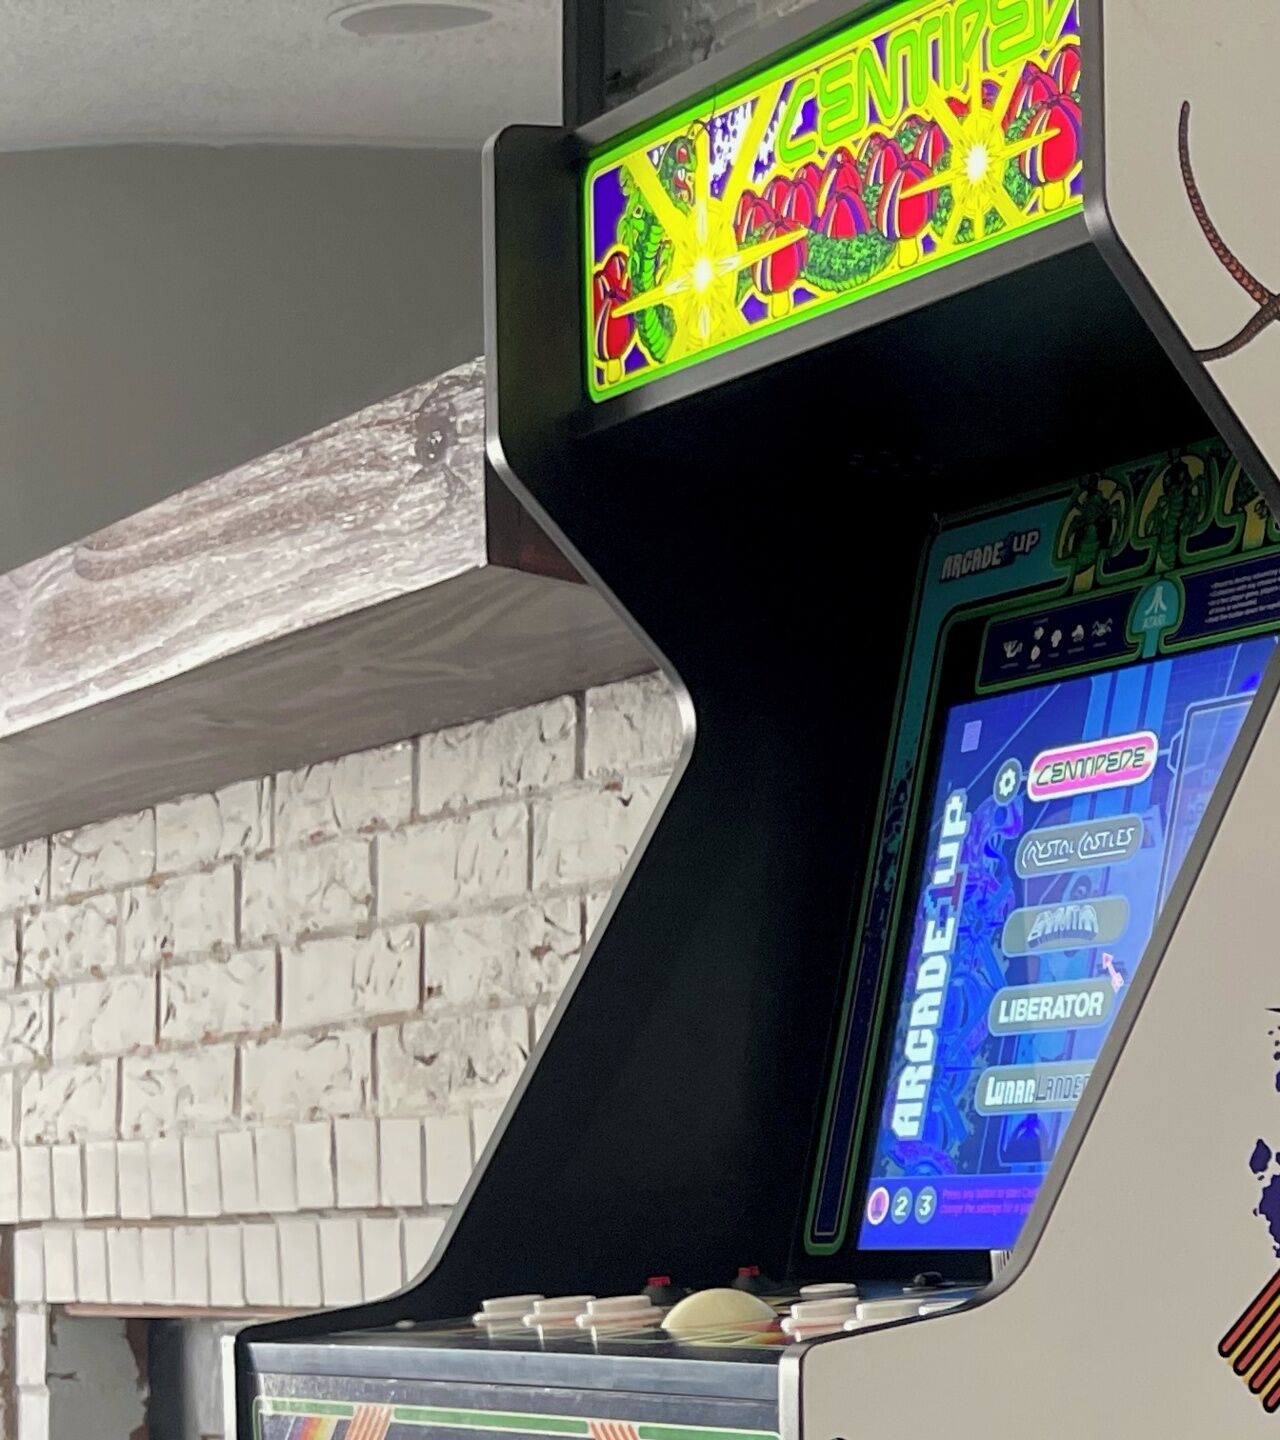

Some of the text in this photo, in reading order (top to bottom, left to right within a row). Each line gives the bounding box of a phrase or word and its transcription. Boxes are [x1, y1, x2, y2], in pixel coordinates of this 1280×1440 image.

[1036, 746, 1147, 786] CENTIPEDE
[1022, 827, 1136, 868] CRYSTAL CASTLES
[891, 789, 968, 1139] ARCADE1UP
[999, 991, 1105, 1024] LIBERATOR
[985, 1076, 1035, 1106] LUNAR
[894, 1196, 907, 1216] 2
[919, 1195, 933, 1216] 3
